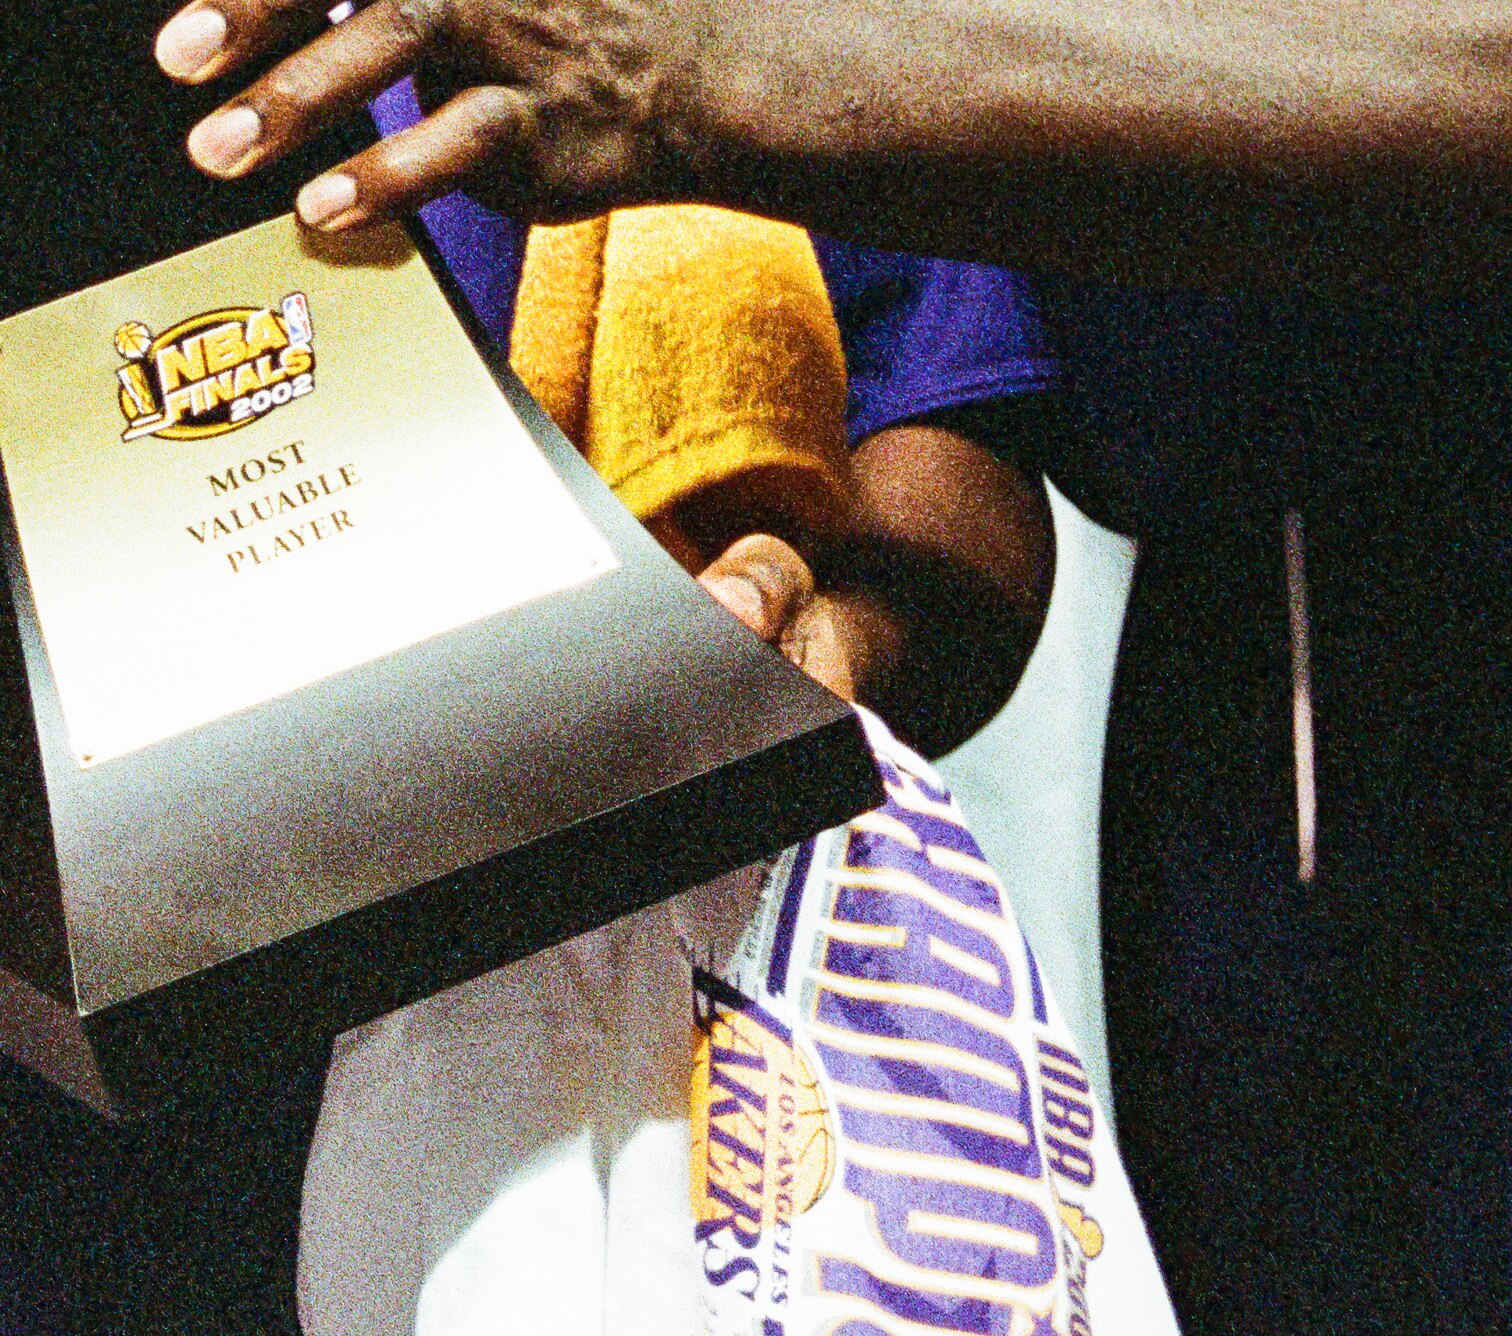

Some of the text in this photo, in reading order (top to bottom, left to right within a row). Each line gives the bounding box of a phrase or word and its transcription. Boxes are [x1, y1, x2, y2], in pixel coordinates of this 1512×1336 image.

[155, 308, 290, 395] NBA
[164, 342, 314, 424] FINALS
[230, 372, 315, 423] 2002
[185, 462, 363, 545] VALUABLE
[205, 438, 307, 497] MOST
[226, 508, 357, 574] PLAYER
[691, 965, 795, 1303] LAKERS
[771, 1072, 797, 1306] LOS ANGELES
